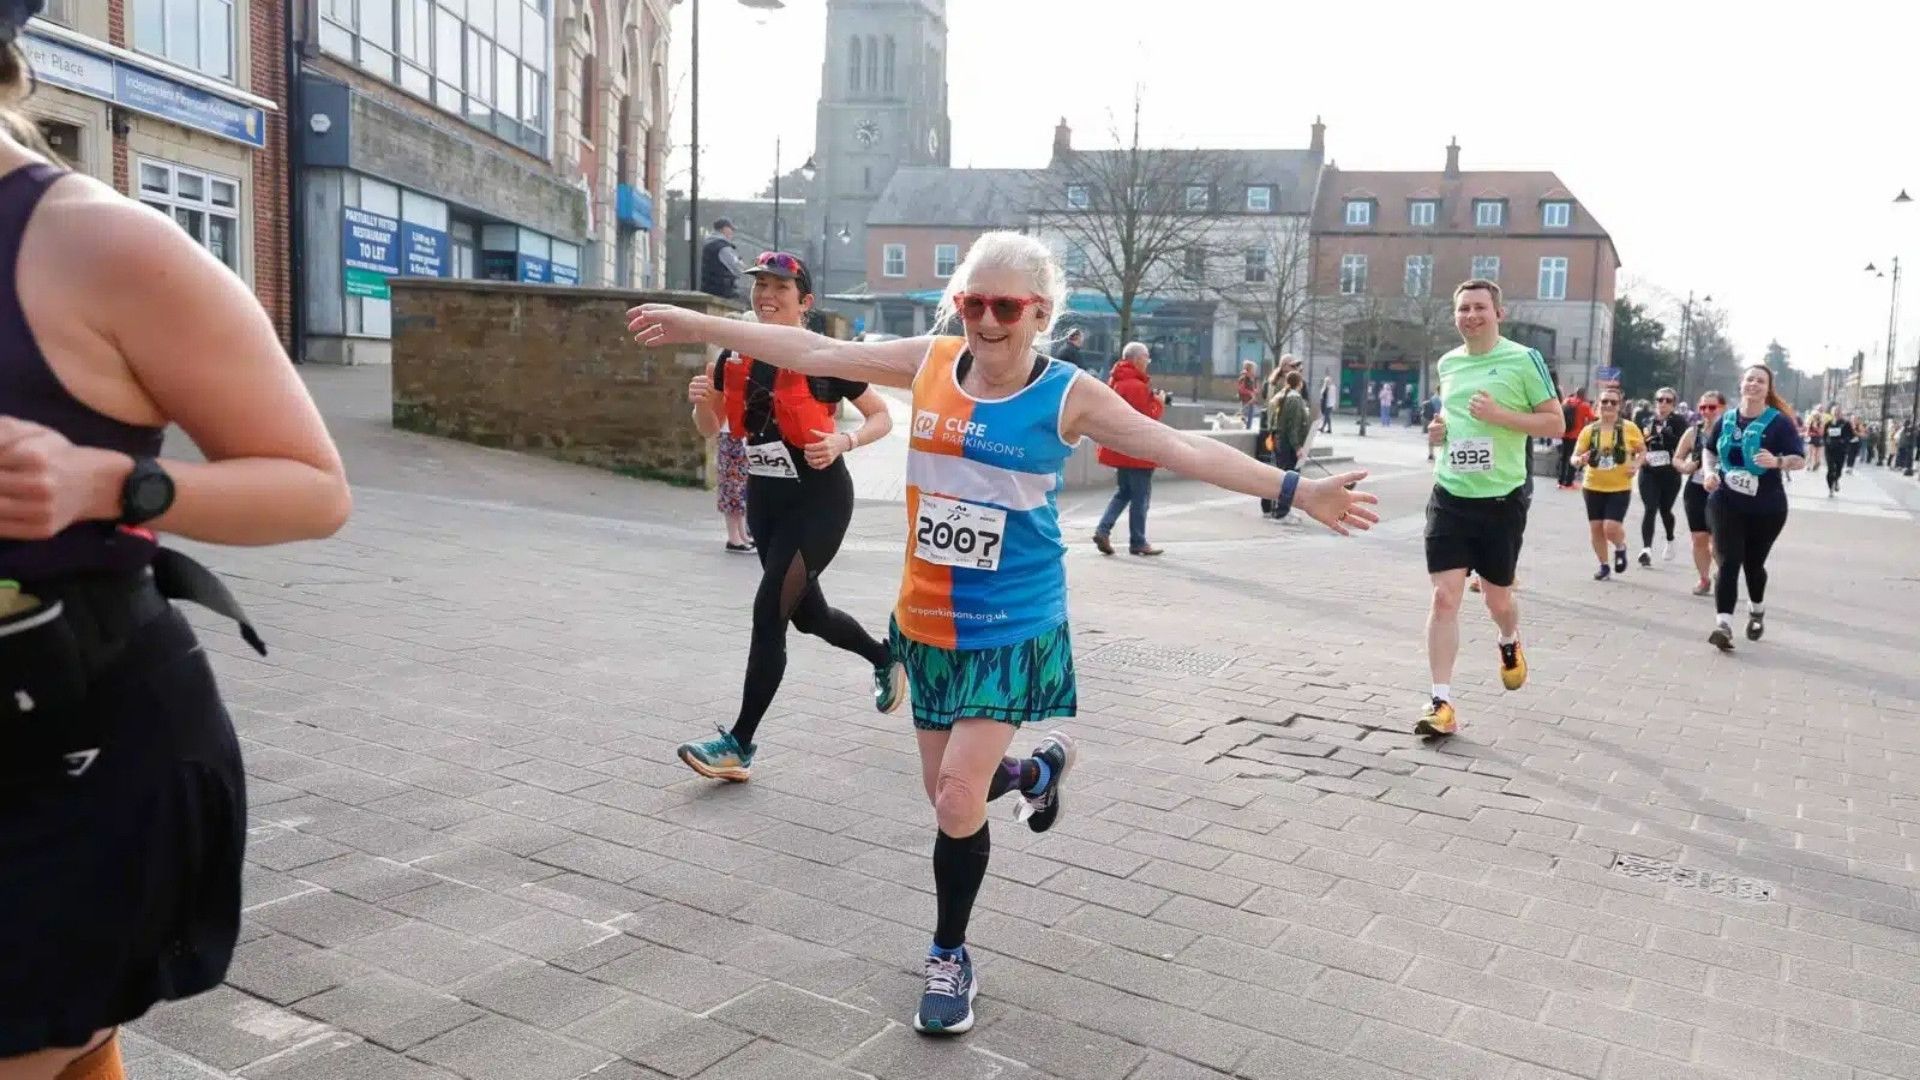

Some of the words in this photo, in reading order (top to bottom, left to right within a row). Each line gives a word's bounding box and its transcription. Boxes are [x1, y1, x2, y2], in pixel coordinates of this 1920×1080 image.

[51, 54, 84, 77] Place
[359, 242, 371, 259] TO
[372, 245, 386, 261] LET
[945, 418, 987, 437] CURE
[942, 433, 1025, 458] PARKINSON'S
[1450, 449, 1490, 464] 1932
[1731, 474, 1750, 489] 511
[917, 516, 999, 557] 2007
